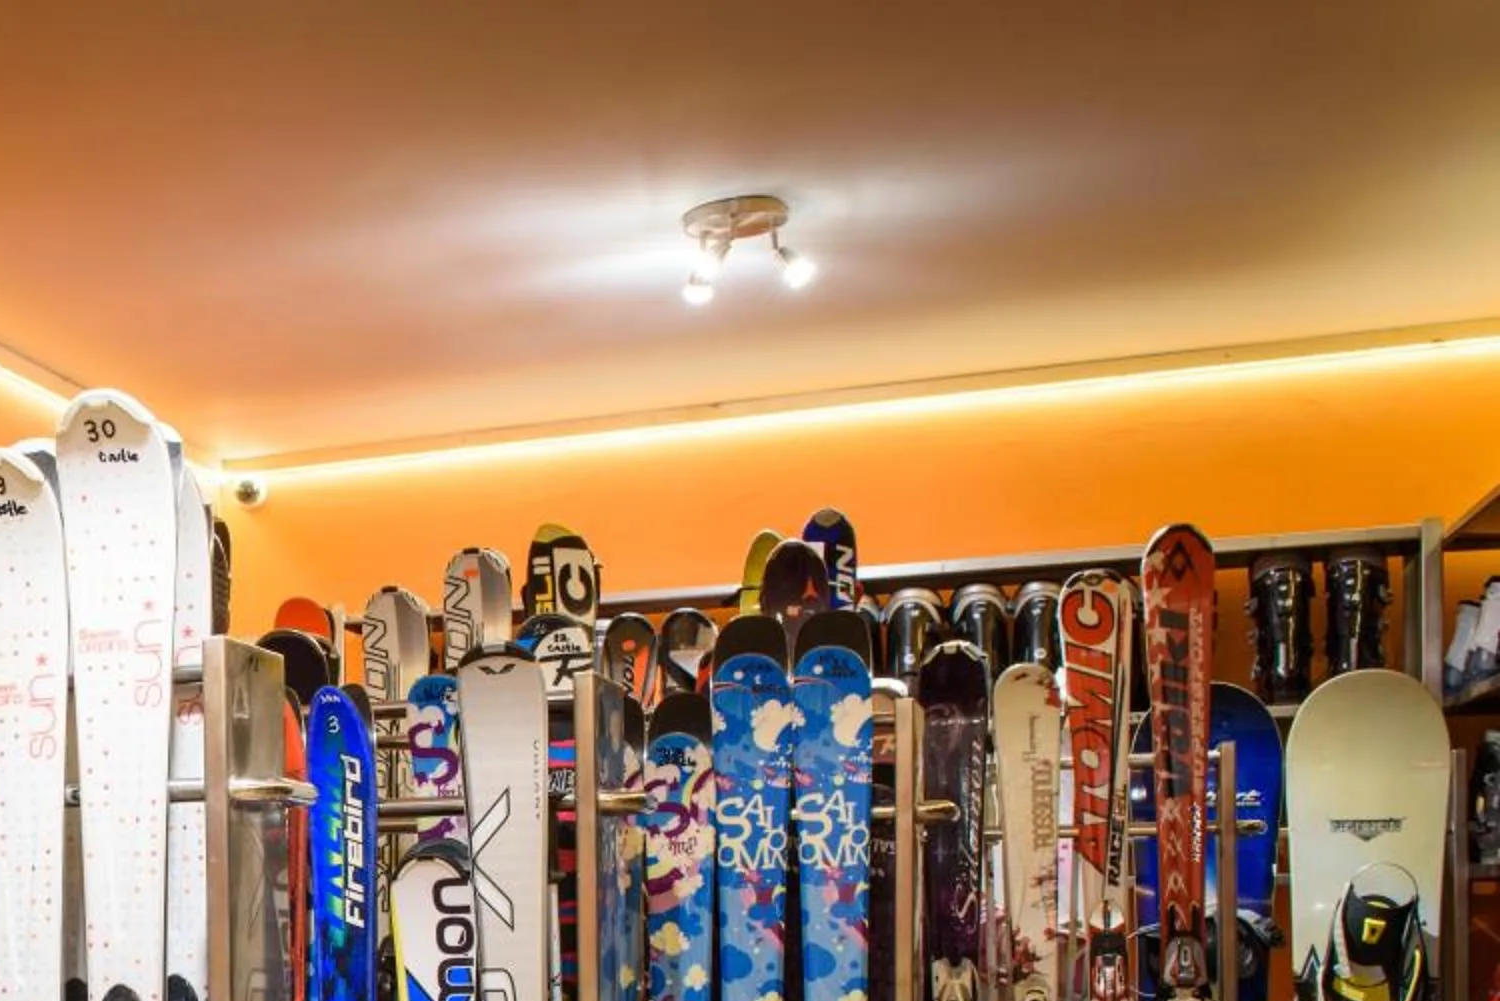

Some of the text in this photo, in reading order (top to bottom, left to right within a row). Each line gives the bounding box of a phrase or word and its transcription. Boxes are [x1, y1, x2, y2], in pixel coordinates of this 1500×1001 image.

[84, 420, 116, 442] 30
[328, 716, 340, 733] 3
[1061, 588, 1117, 875] ATOMIC
[341, 754, 364, 927] Firebird
